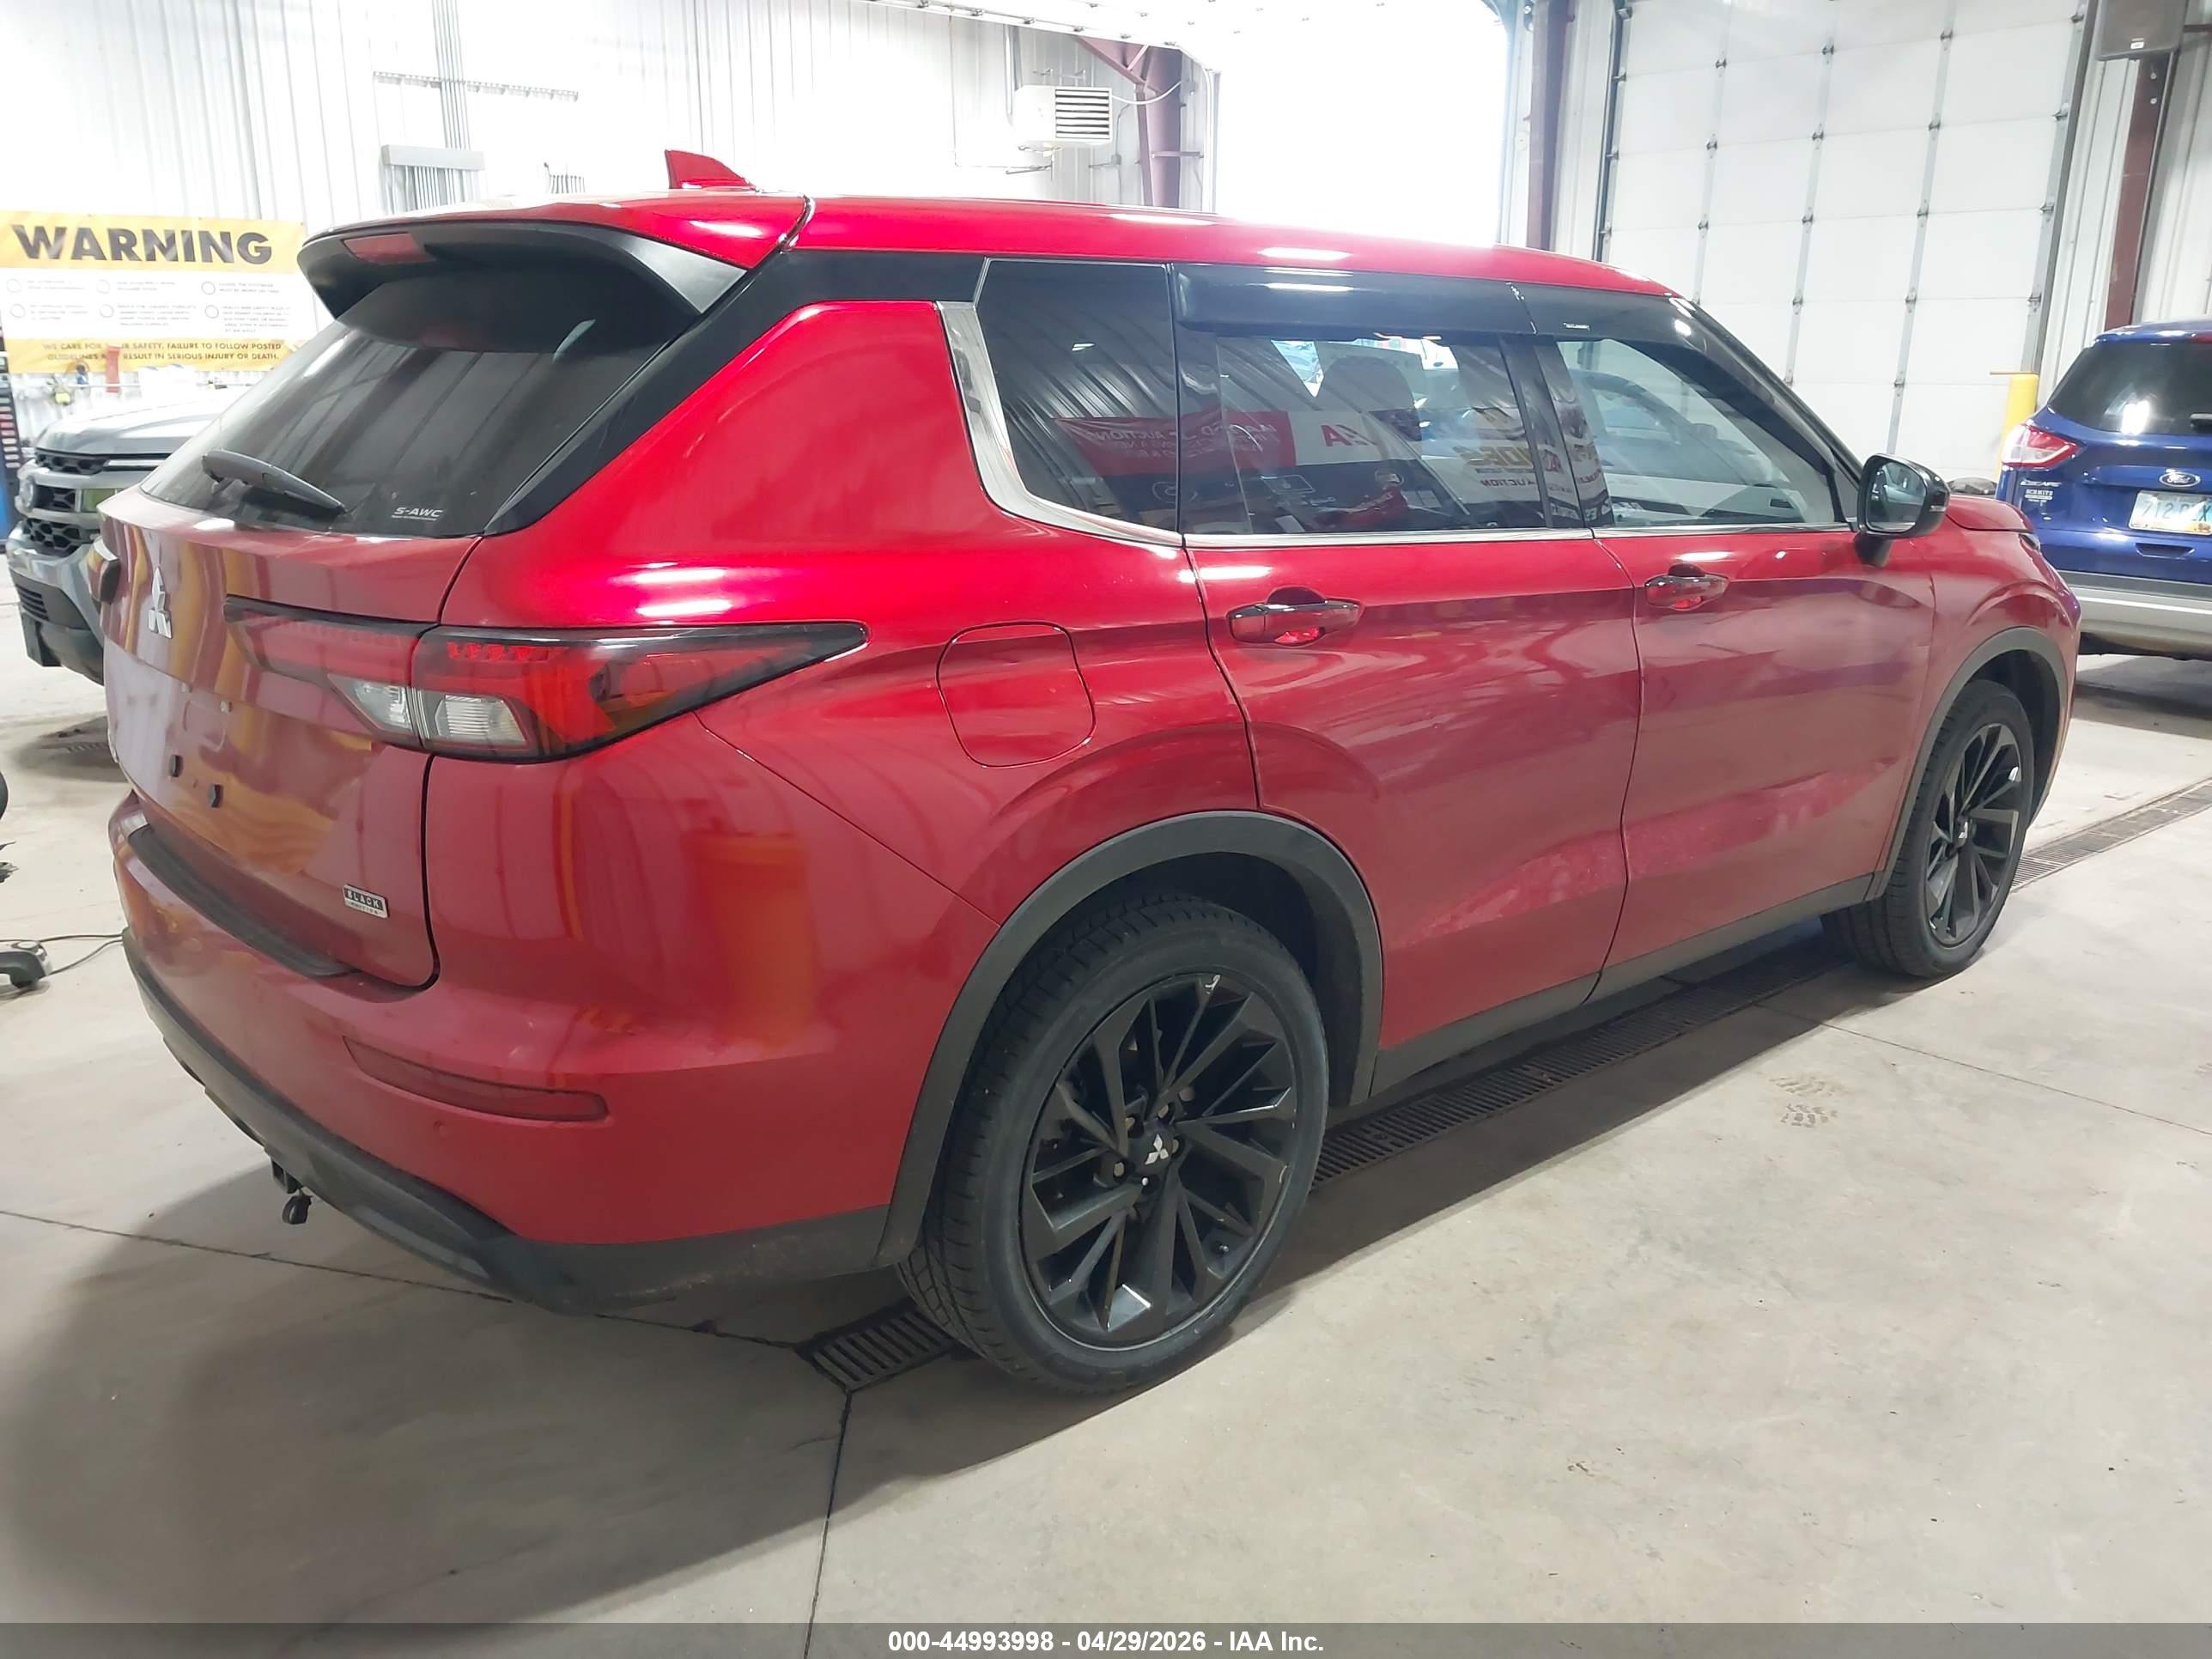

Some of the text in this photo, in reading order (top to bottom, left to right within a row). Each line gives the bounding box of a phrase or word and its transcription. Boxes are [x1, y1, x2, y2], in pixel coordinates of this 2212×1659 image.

[12, 225, 272, 264] WARNING
[394, 507, 443, 517] S-AWC
[347, 890, 379, 908] BLACK
